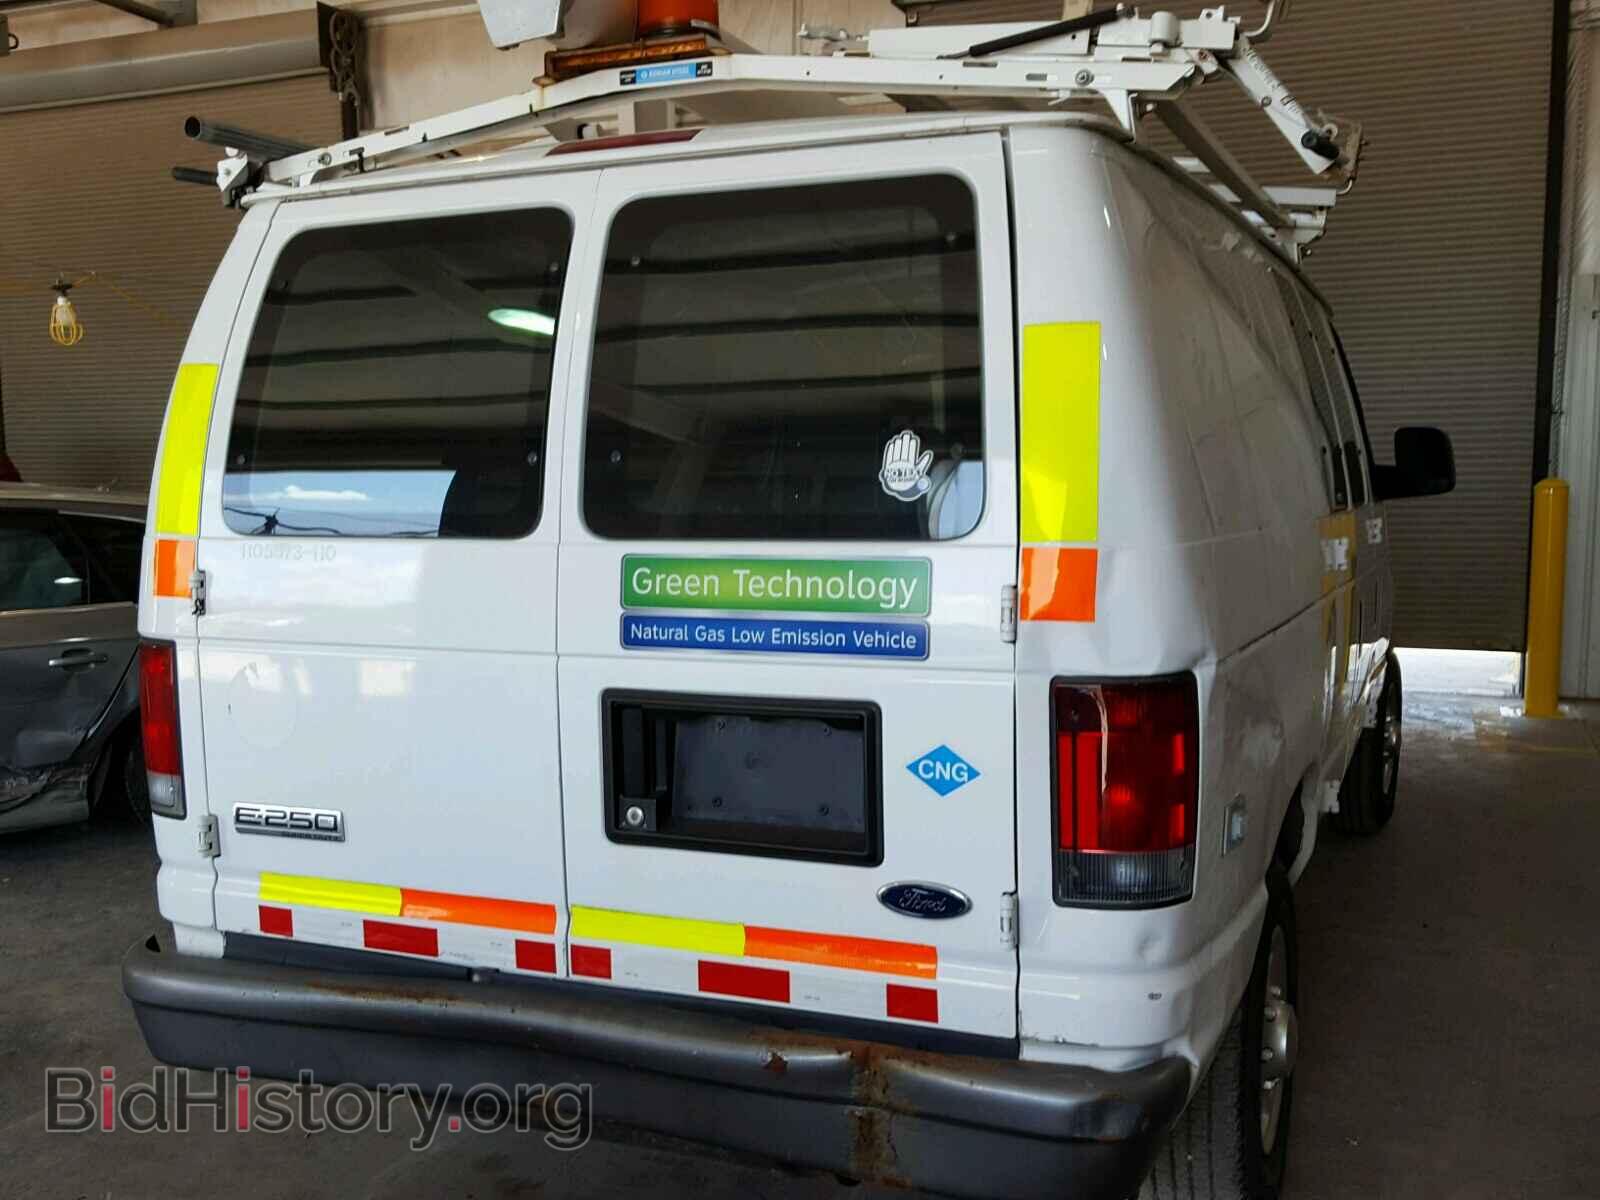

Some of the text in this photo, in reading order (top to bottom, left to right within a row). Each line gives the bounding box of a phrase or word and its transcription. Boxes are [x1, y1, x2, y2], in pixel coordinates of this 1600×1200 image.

[632, 567, 918, 609] Green Technology
[631, 623, 917, 649] Natural Gas Low Emission Vehicle
[918, 759, 968, 783] CNG
[899, 887, 946, 913] Ford
